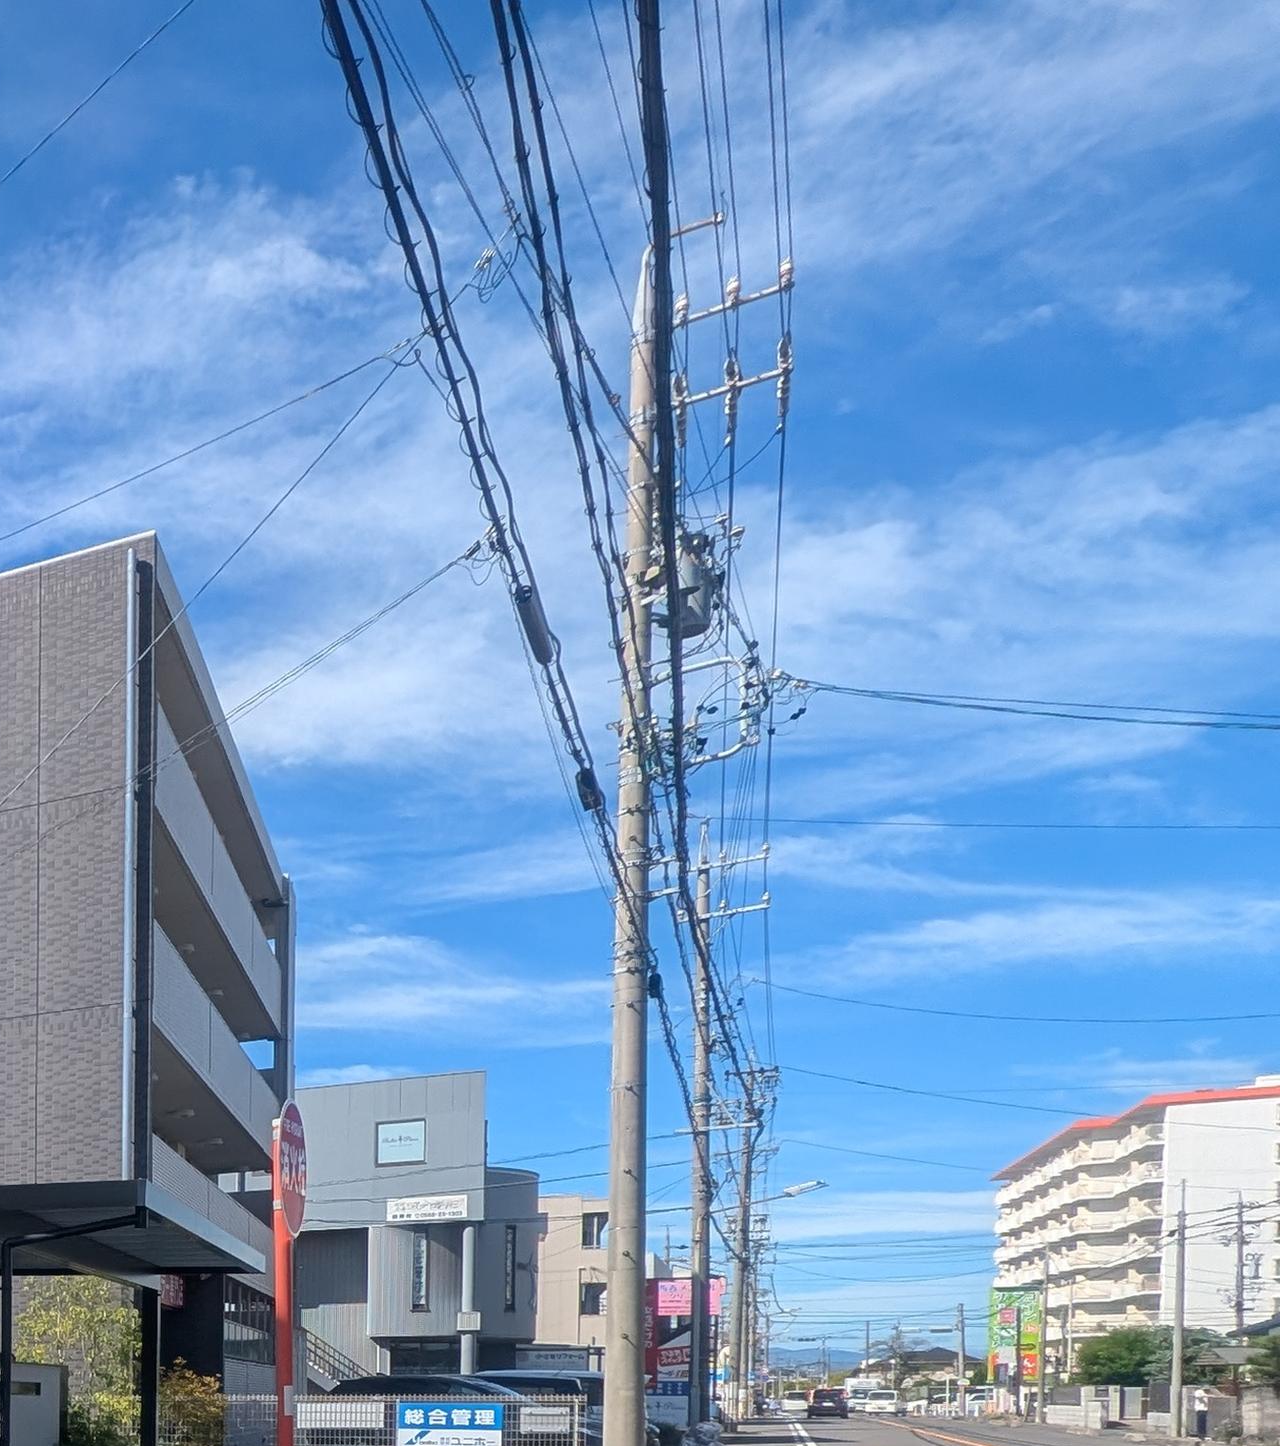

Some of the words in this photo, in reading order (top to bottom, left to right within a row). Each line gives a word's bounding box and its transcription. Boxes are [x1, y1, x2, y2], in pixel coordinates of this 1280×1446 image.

[282, 1142, 306, 1196] 消火栓
[404, 1408, 496, 1426] 総合管理
[451, 1437, 496, 1446] ユニホー
